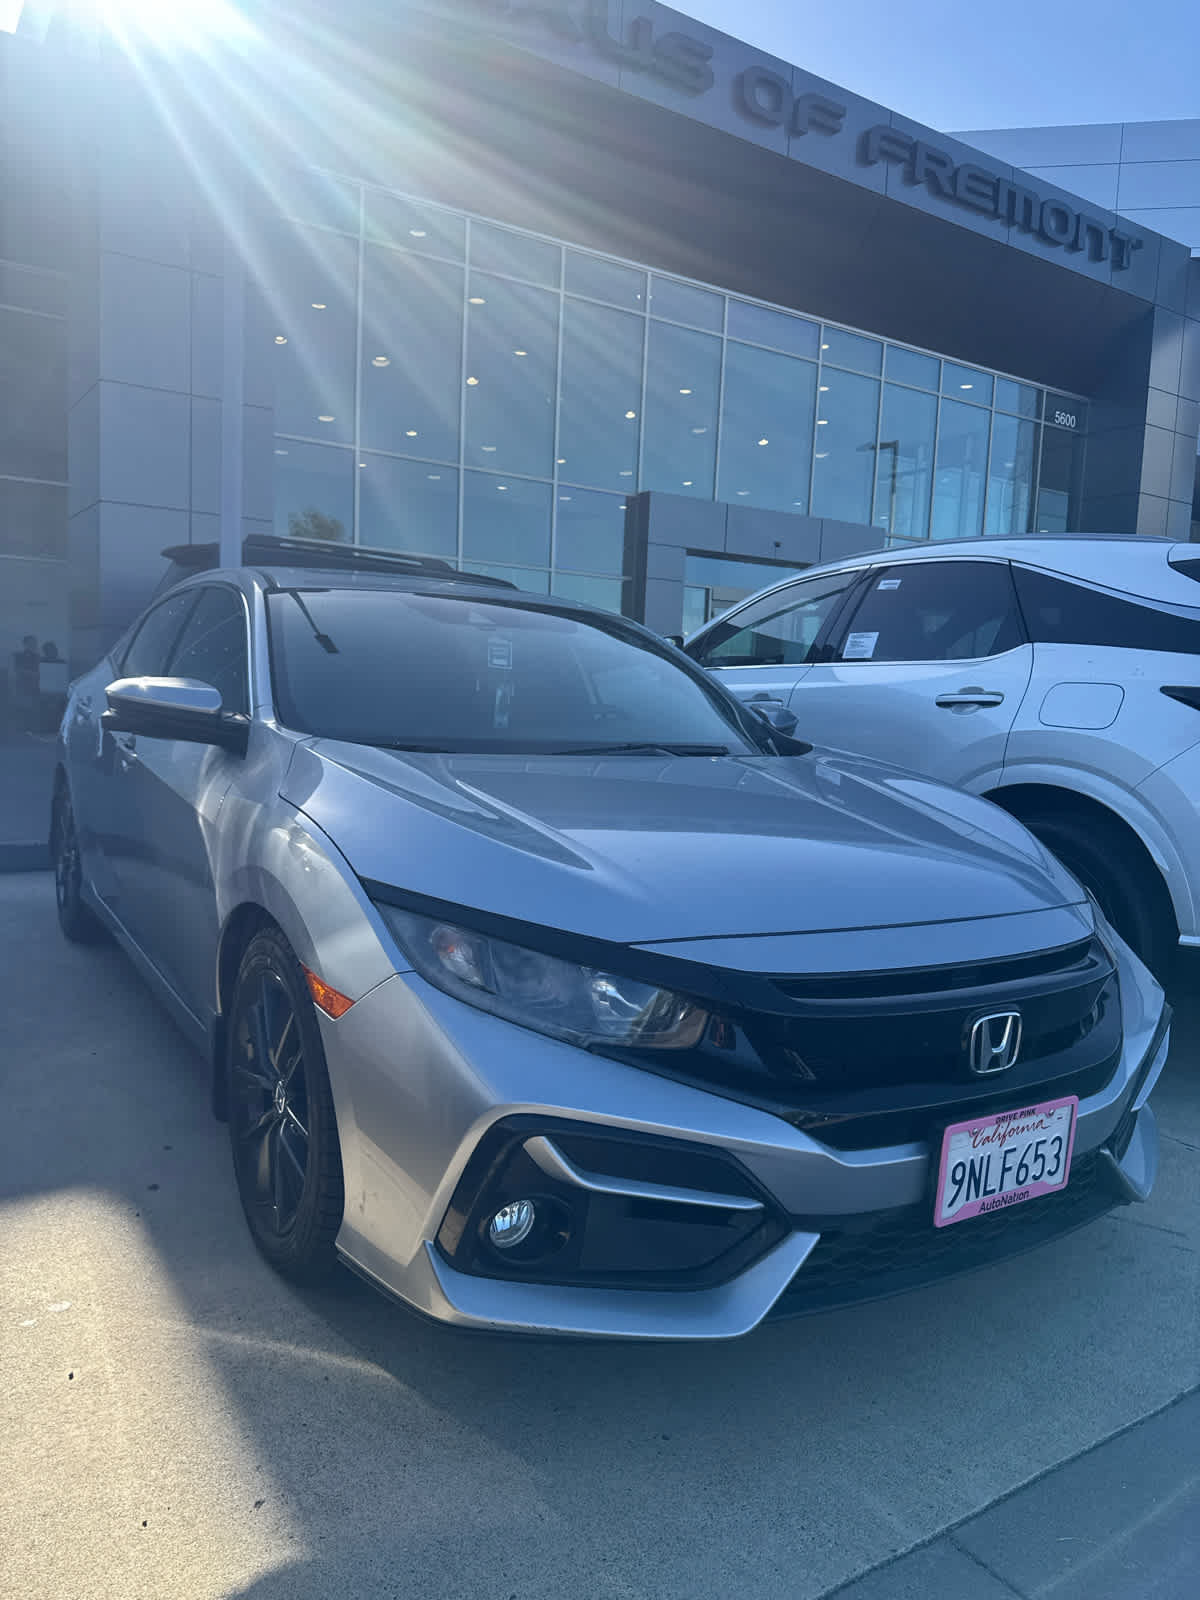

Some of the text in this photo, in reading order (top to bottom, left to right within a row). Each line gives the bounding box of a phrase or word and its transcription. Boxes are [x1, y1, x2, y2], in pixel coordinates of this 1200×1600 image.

[731, 65, 847, 137] OF
[855, 124, 1143, 271] FREMONT
[1054, 410, 1076, 428] 5600
[971, 1119, 1050, 1149] California
[947, 1135, 1063, 1209] 9NLF653
[978, 1189, 1030, 1213] AutoNation
